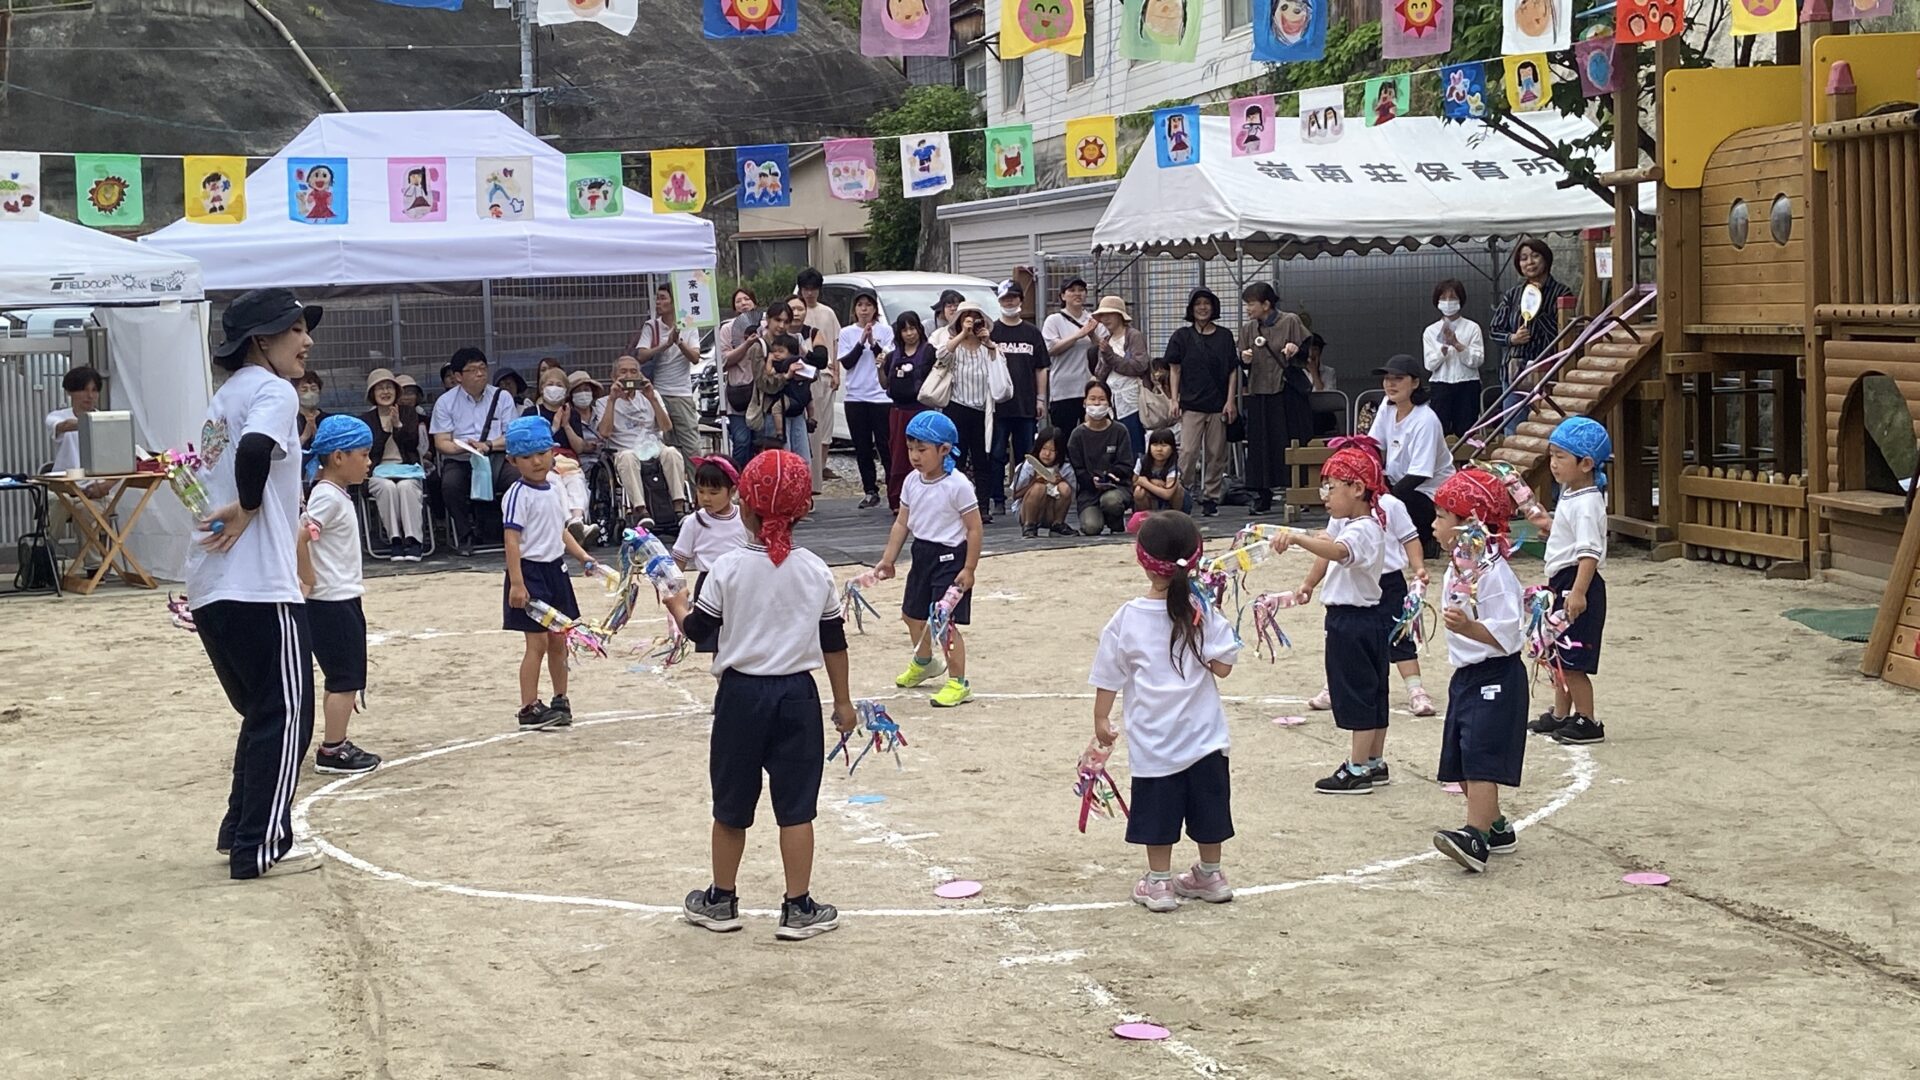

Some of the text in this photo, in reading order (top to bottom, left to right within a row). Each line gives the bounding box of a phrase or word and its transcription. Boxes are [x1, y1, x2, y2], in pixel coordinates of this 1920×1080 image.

[1254, 157, 1560, 184] 嶺南荘保育所
[63, 280, 112, 290] FIELDOOR
